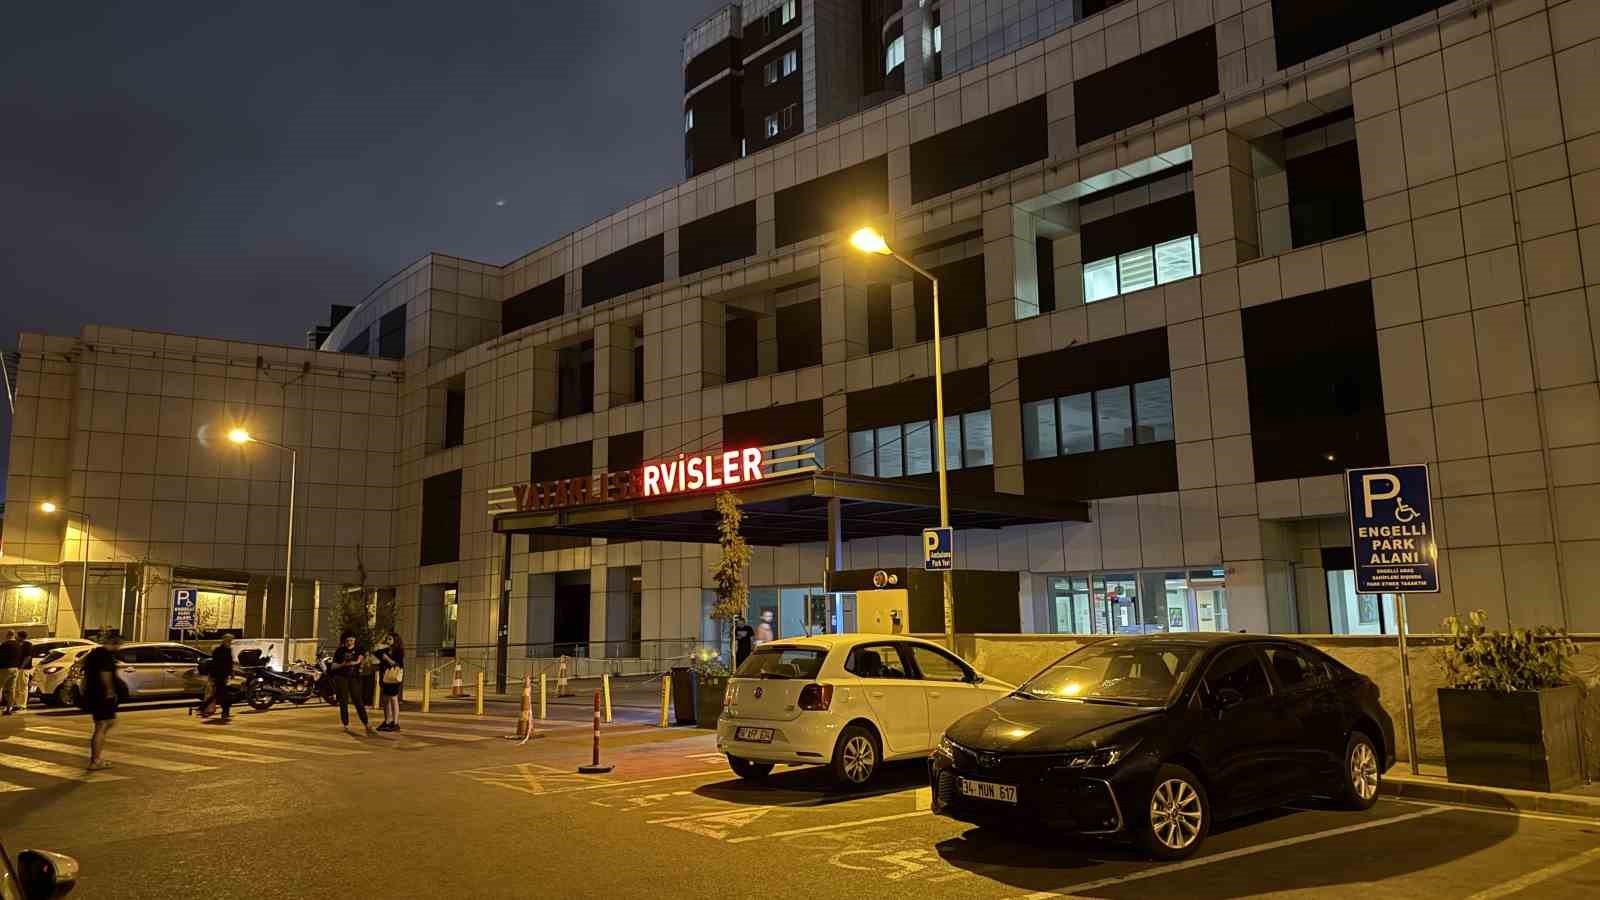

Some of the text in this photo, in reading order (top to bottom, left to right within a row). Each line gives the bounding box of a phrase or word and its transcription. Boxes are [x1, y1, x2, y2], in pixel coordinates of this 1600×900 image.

[1362, 473, 1400, 518] P
[1358, 522, 1426, 538] ENGELLİ
[924, 531, 939, 561] P
[1372, 538, 1415, 550] PARK
[1370, 552, 1419, 564] ALANI
[177, 591, 189, 605] P
[1000, 785, 1015, 800] 617
